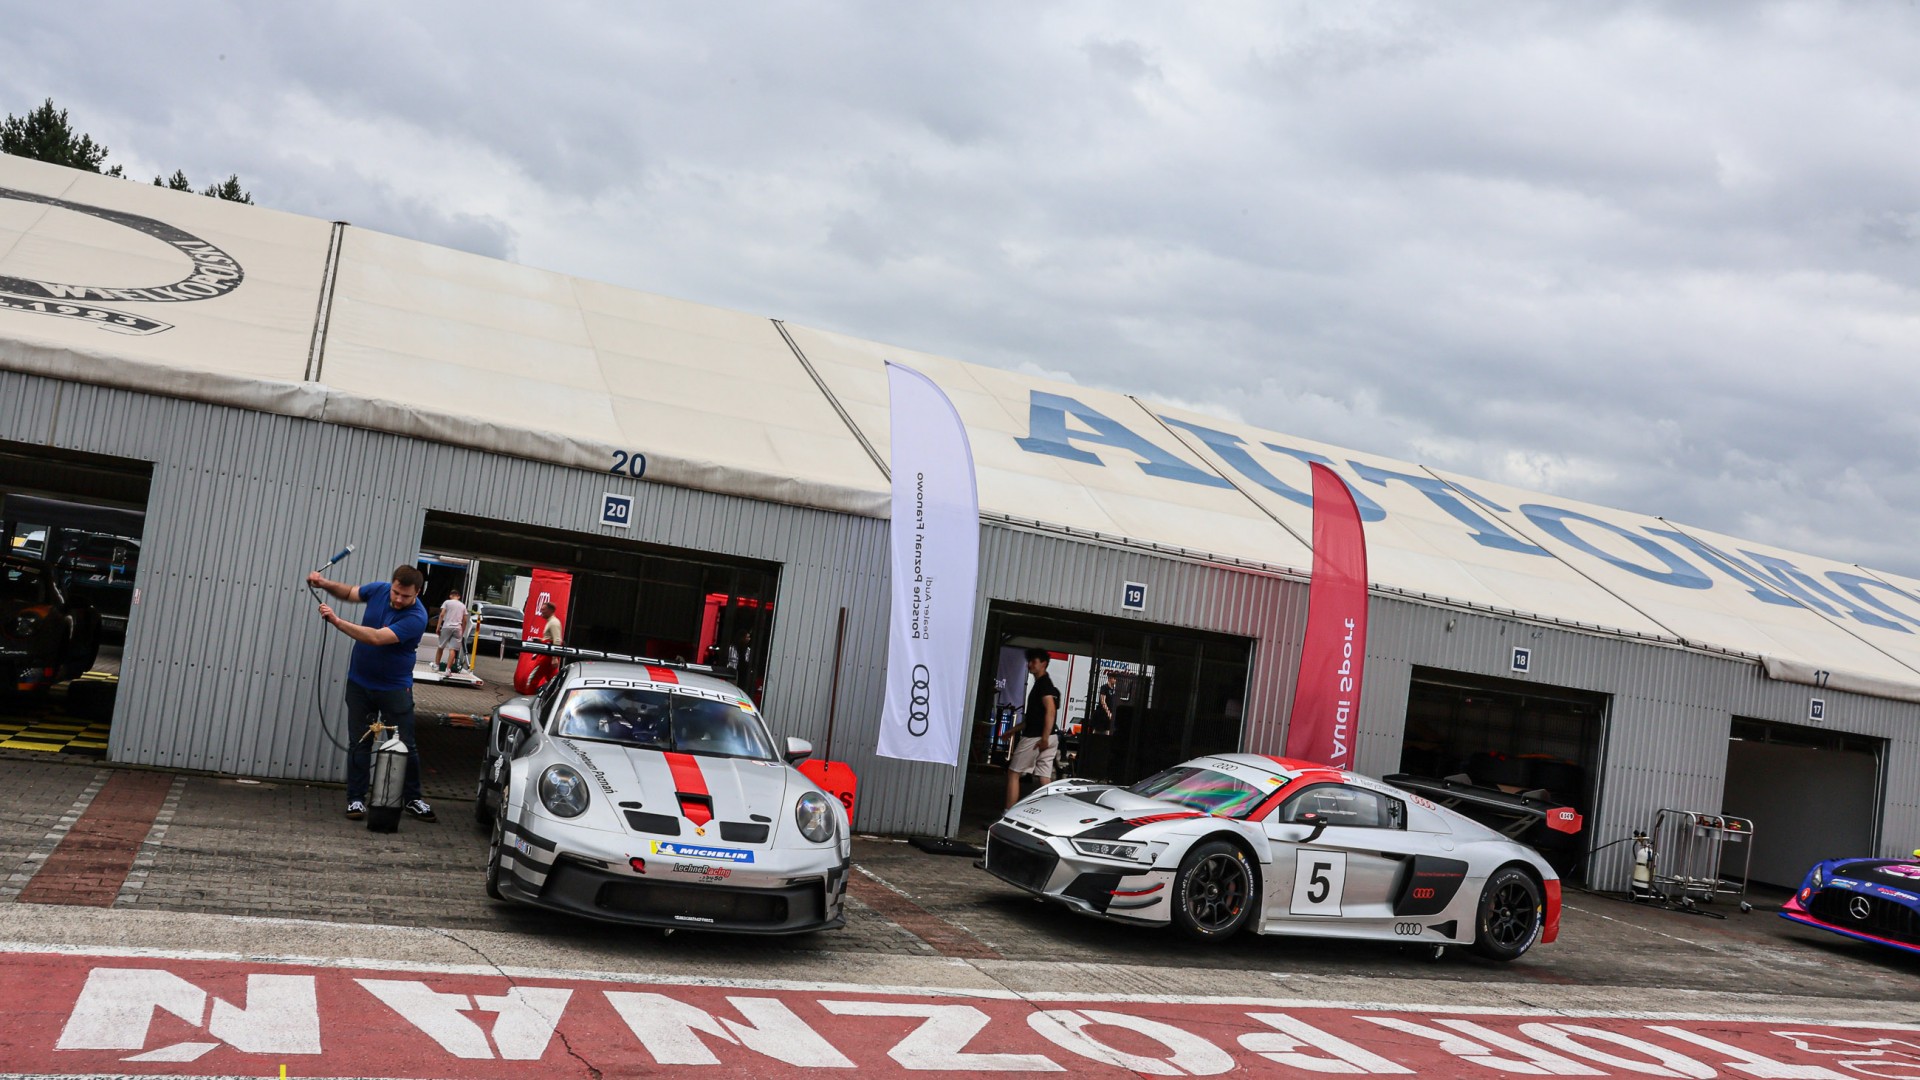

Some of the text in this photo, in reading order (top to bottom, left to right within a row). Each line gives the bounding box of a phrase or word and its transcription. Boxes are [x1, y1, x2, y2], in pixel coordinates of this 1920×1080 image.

[609, 450, 646, 478] 20
[606, 502, 627, 518] 20
[1014, 389, 1920, 634] AUTOMO
[1128, 590, 1141, 603] 19
[521, 641, 713, 672] PORSCHE
[1515, 654, 1527, 666] 18
[1813, 669, 1830, 689] 17
[584, 678, 739, 704] PORSCHE
[1813, 705, 1822, 715] 17
[679, 847, 748, 860] MICHELIN
[1307, 862, 1332, 904] 5
[54, 967, 1417, 1077] POZNAŃ
